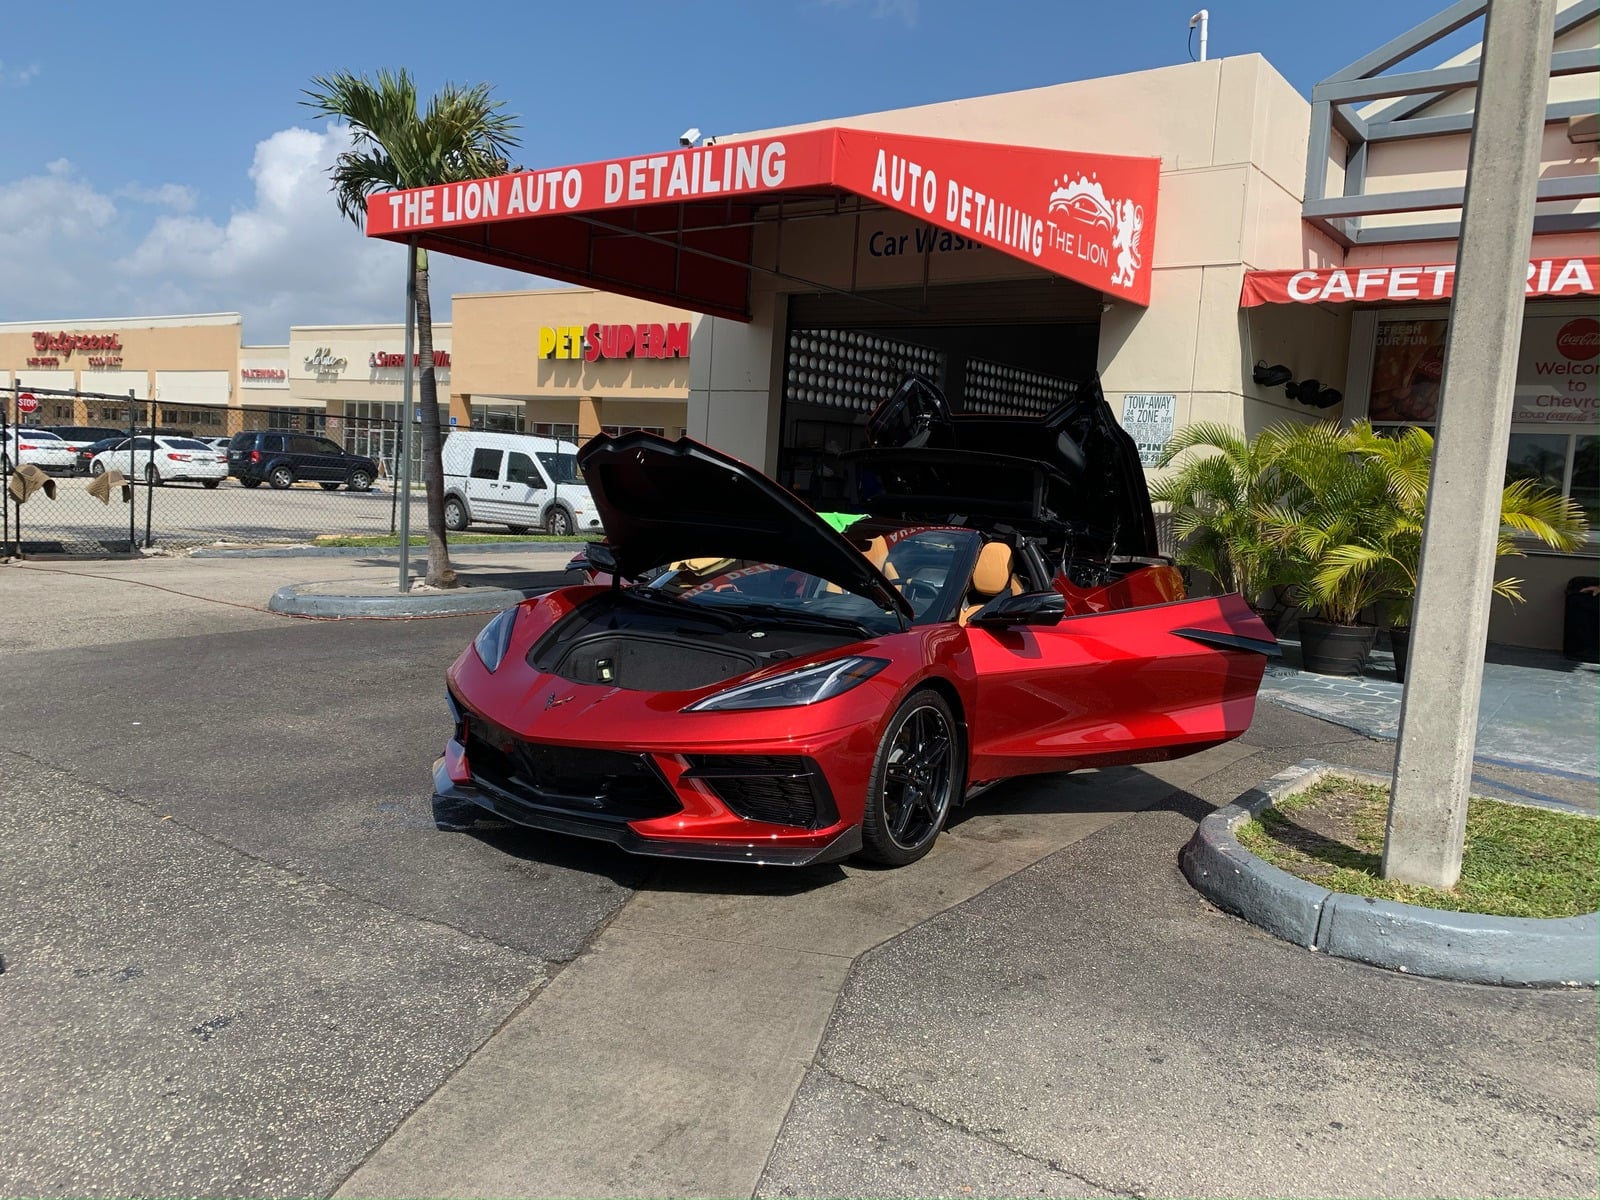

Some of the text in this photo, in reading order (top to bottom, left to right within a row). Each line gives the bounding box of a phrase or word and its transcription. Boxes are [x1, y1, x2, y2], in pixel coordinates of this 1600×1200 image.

[389, 141, 786, 229] THE LION AUTO DETAILING
[871, 149, 1043, 257] AUTO DETAILING
[869, 227, 982, 257] Car Was
[1047, 220, 1109, 268] THE LION
[1287, 259, 1594, 301] CAFETIA
[32, 331, 123, 357] Walgreens
[538, 325, 584, 360] PET
[1535, 361, 1600, 375] Welco
[1567, 378, 1587, 392] to
[18, 398, 36, 407] STOP
[1128, 396, 1171, 409] TOW-AWAY
[1137, 409, 1159, 423] ZONE
